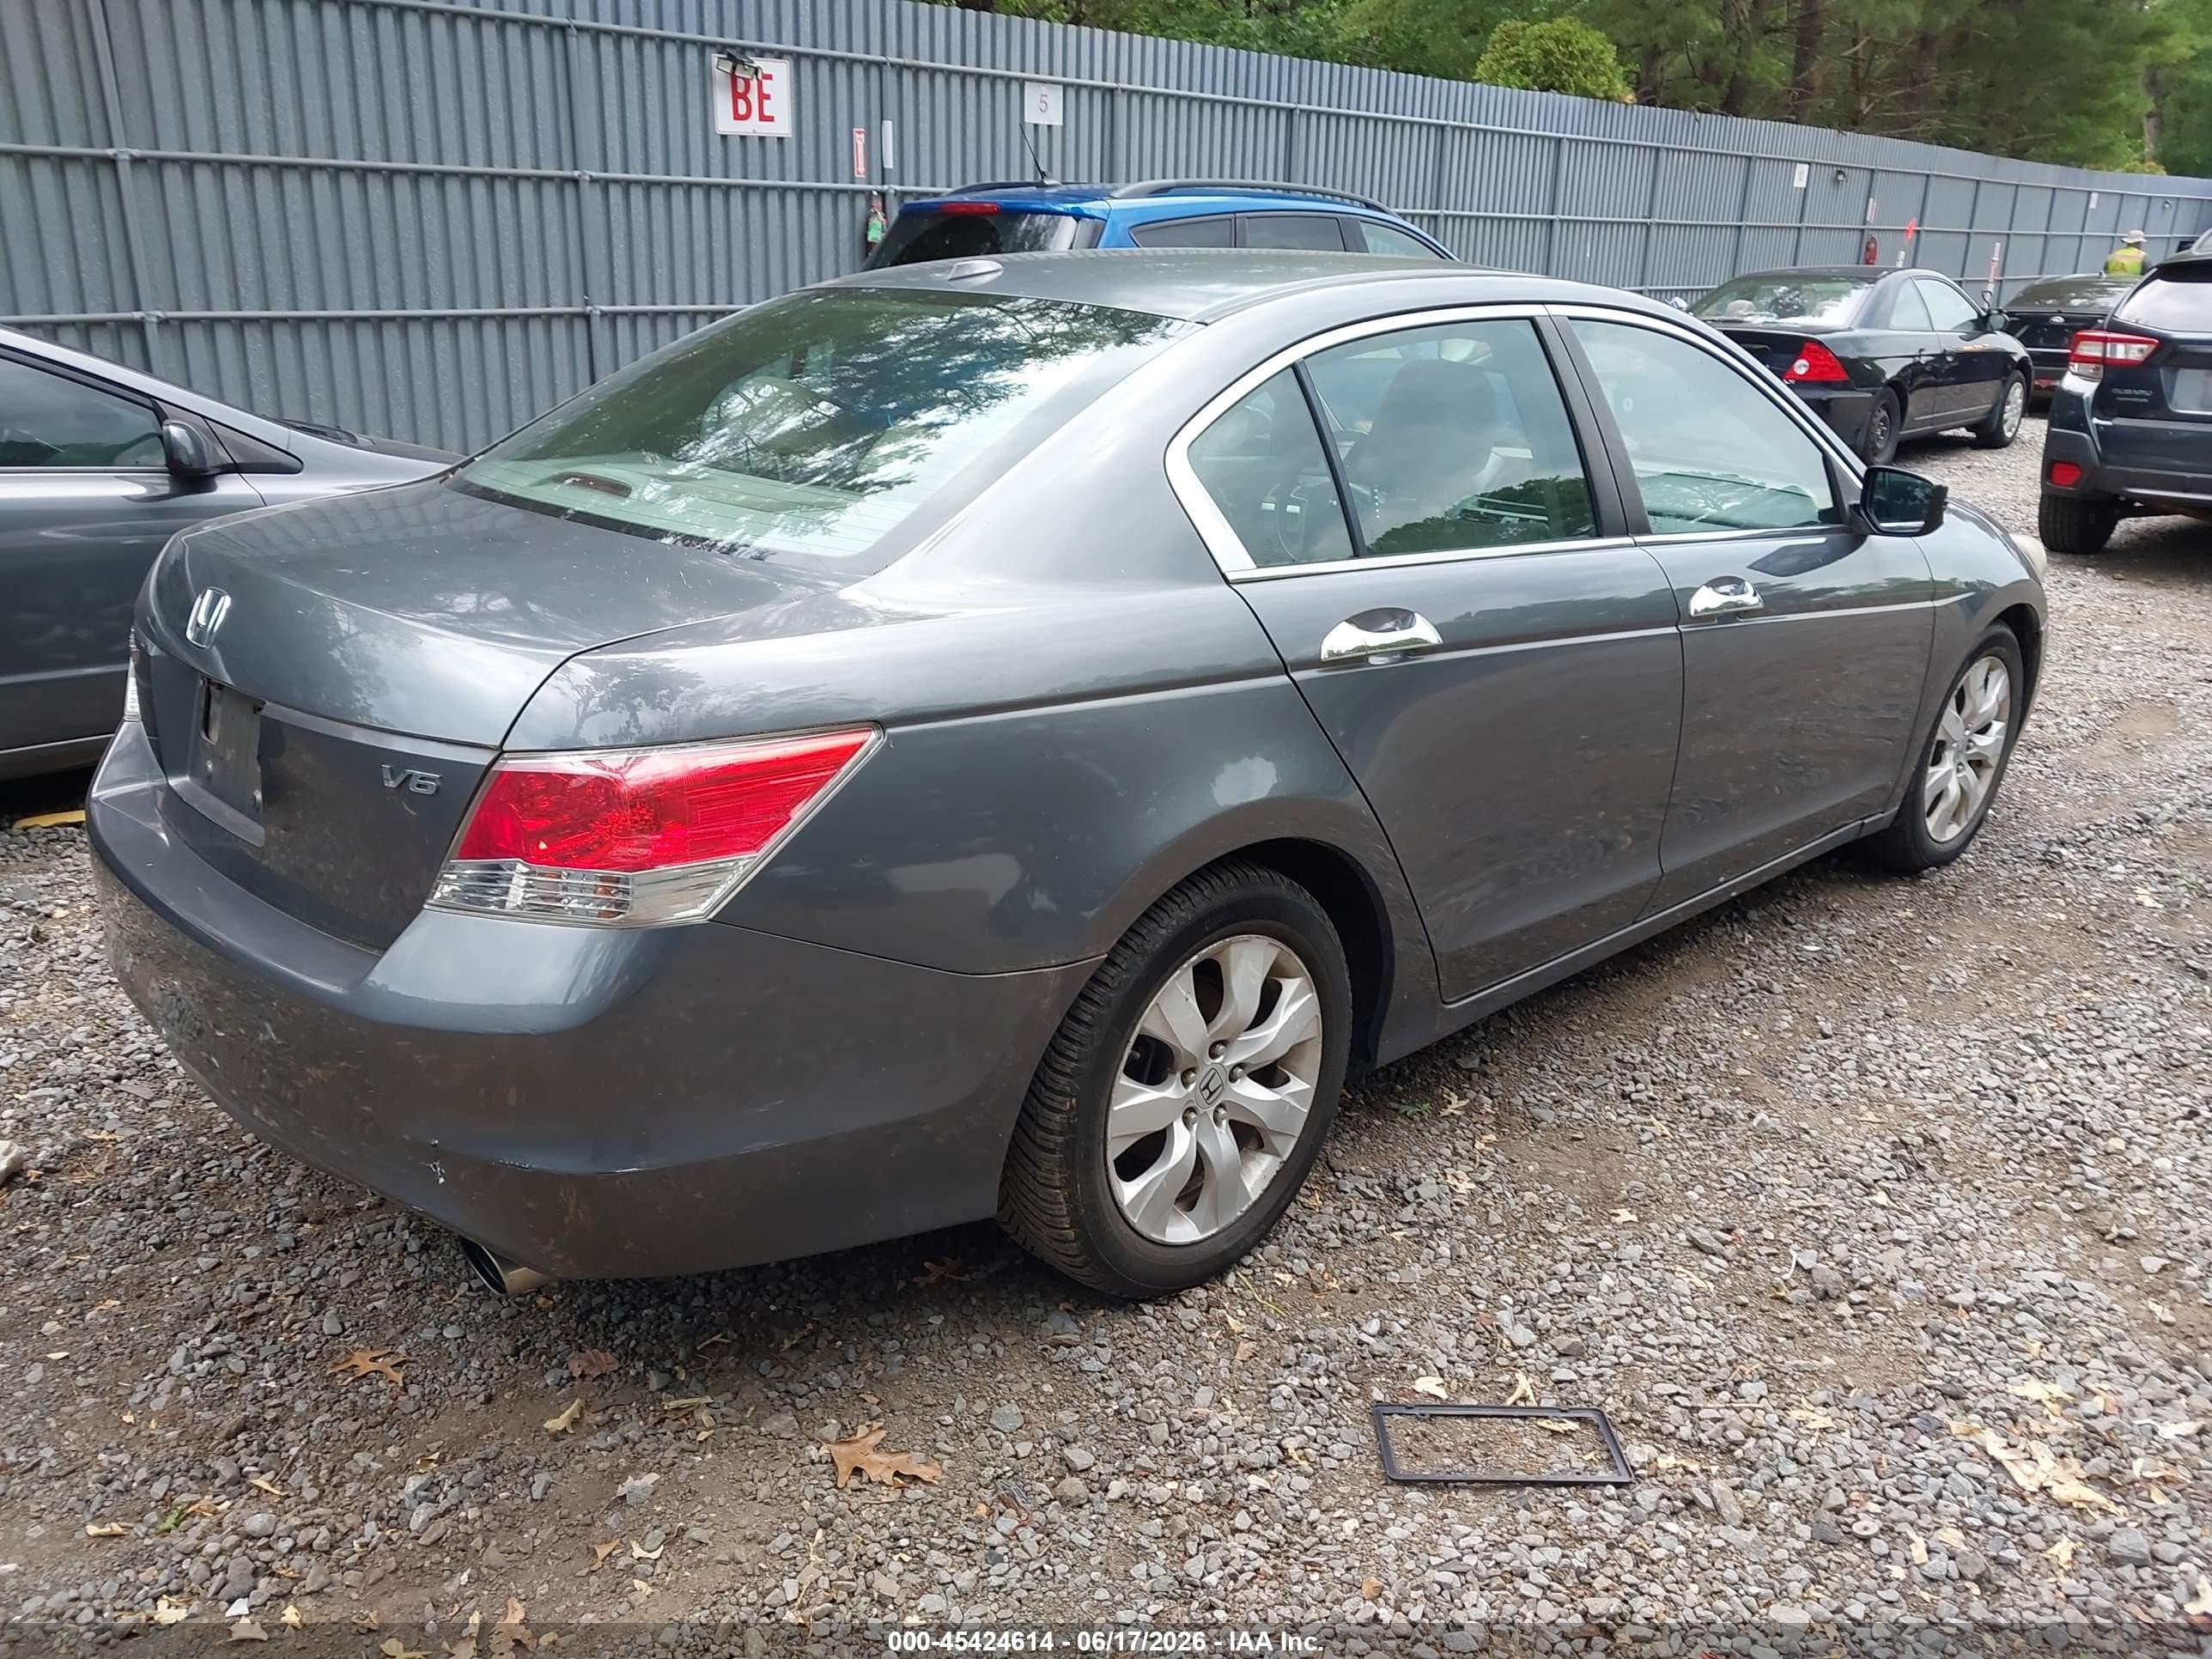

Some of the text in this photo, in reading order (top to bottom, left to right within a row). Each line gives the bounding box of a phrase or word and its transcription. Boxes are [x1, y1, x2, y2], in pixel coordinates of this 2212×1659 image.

[731, 72, 775, 122] BE
[1039, 94, 1048, 112] 5
[380, 764, 441, 795] V6
